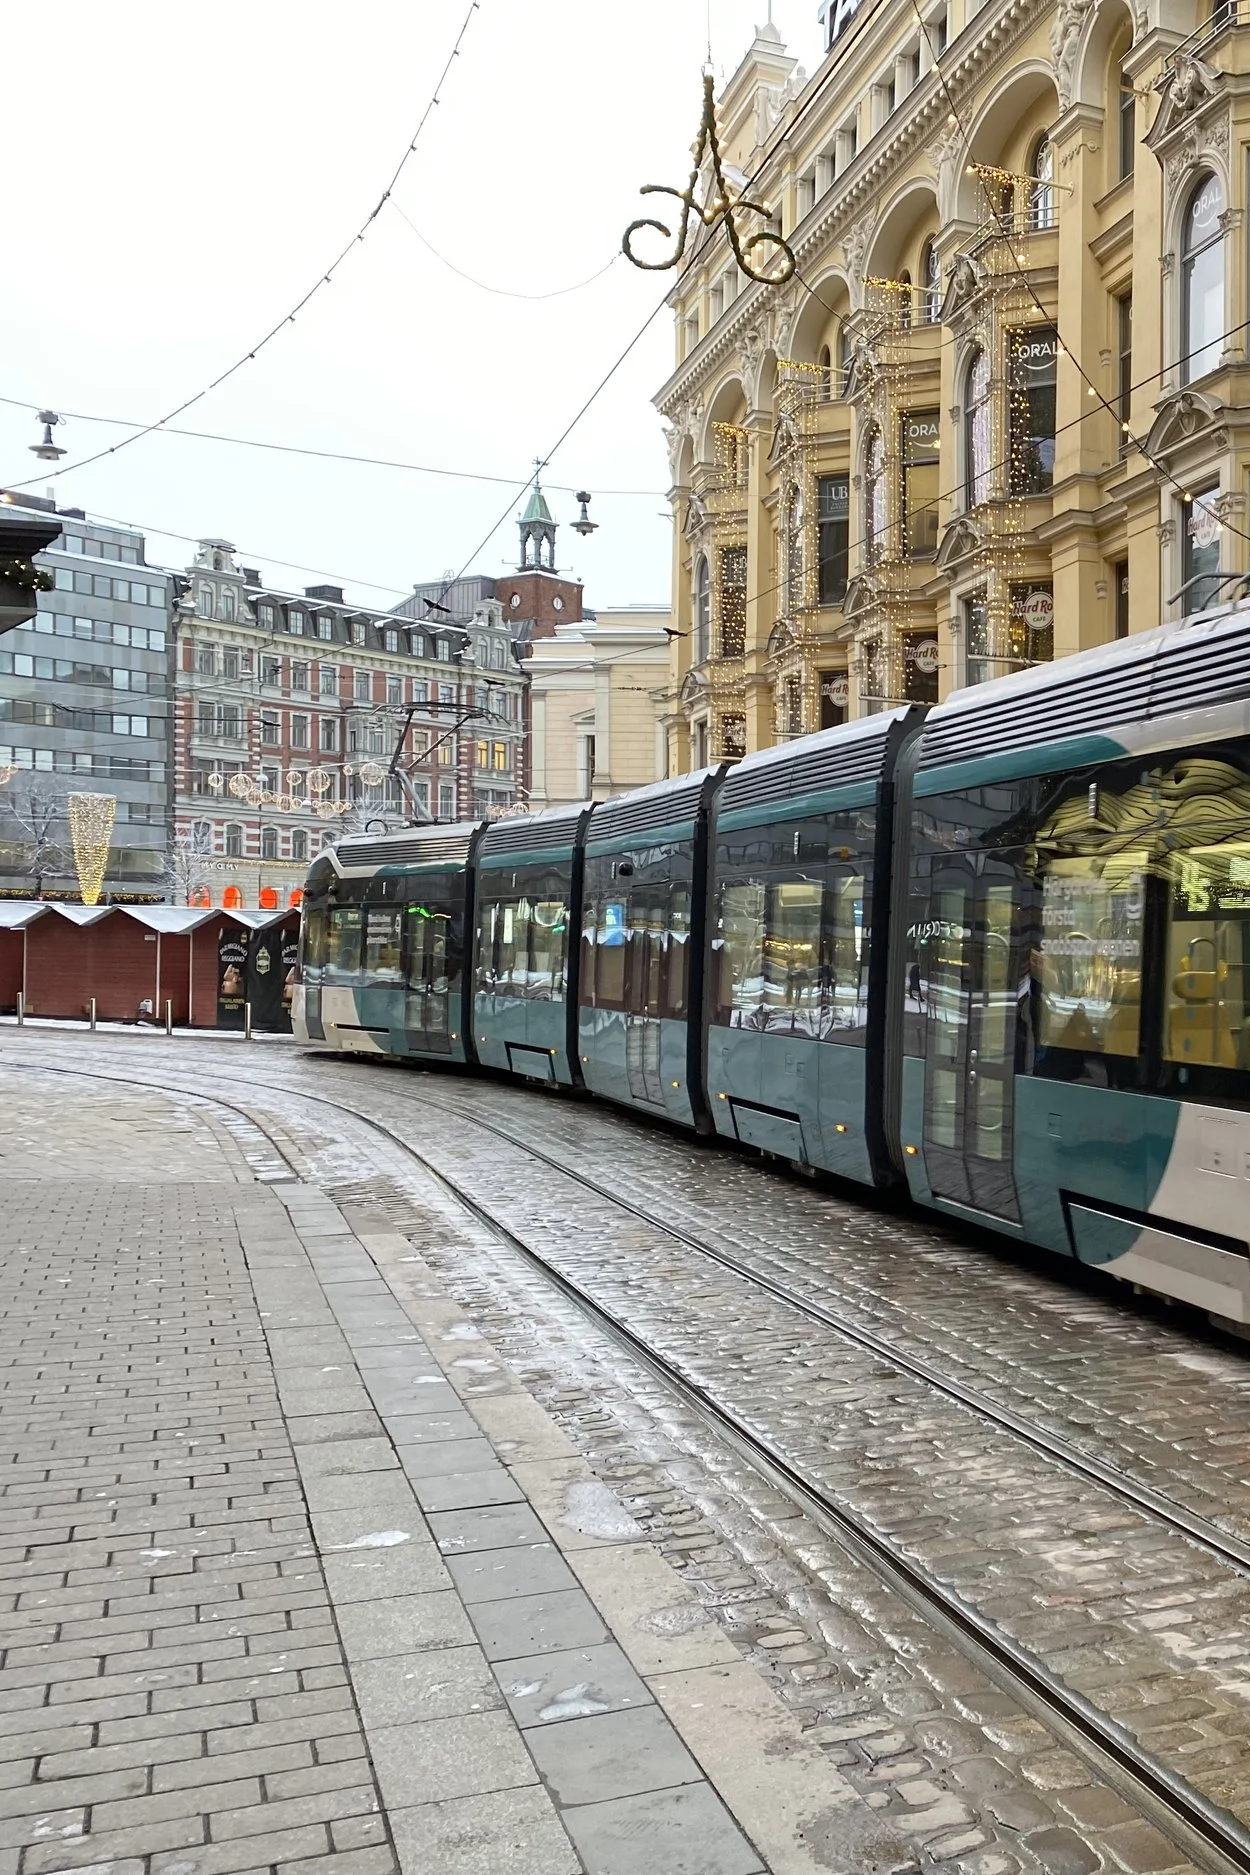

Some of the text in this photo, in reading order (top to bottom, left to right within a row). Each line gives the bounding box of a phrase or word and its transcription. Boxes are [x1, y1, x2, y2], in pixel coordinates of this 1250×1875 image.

[1193, 187, 1222, 218] ORAL
[1018, 341, 1058, 358] ORAL
[1013, 600, 1039, 615] Hard
[905, 647, 929, 659] Hard
[822, 684, 841, 695] Hard
